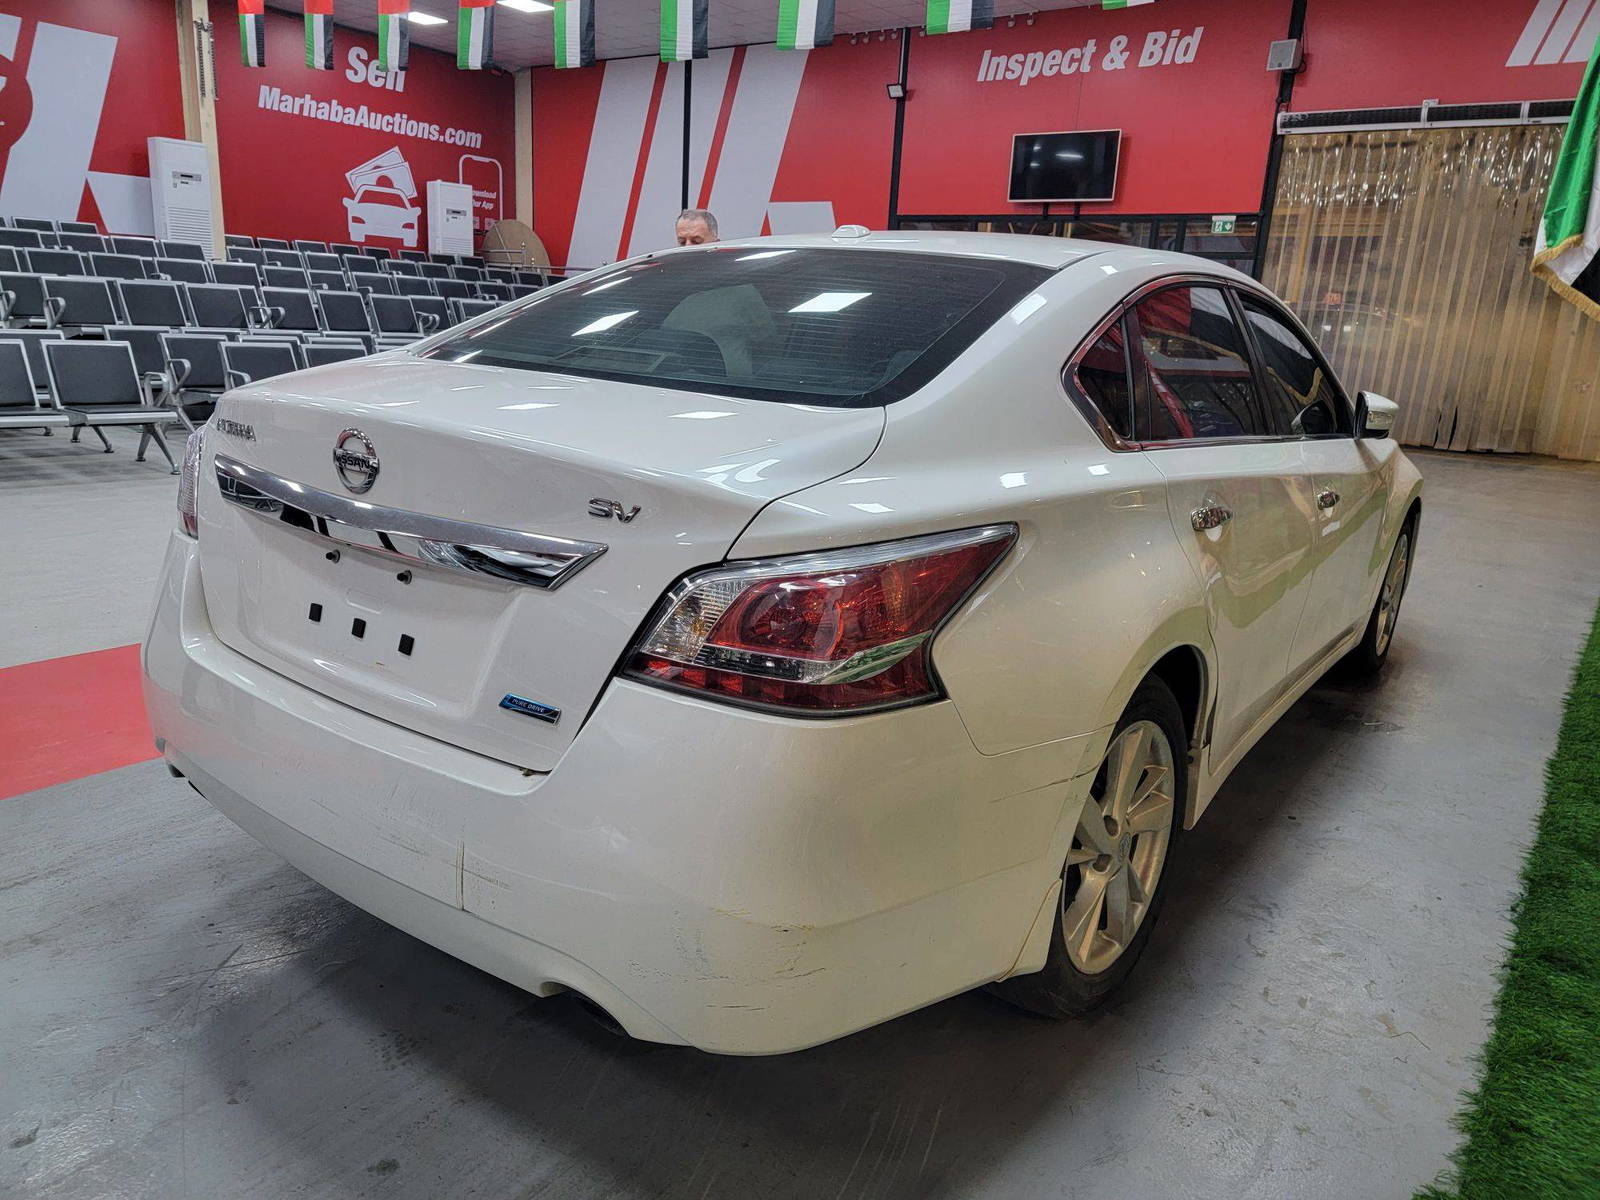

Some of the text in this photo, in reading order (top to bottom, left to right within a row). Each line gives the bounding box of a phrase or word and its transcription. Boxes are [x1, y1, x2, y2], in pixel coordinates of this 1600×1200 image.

[977, 26, 1204, 86] Inspect & Bid
[258, 85, 482, 149] MarhabaAuctions.com
[588, 498, 641, 523] SV
[528, 704, 545, 712] DRIVE
